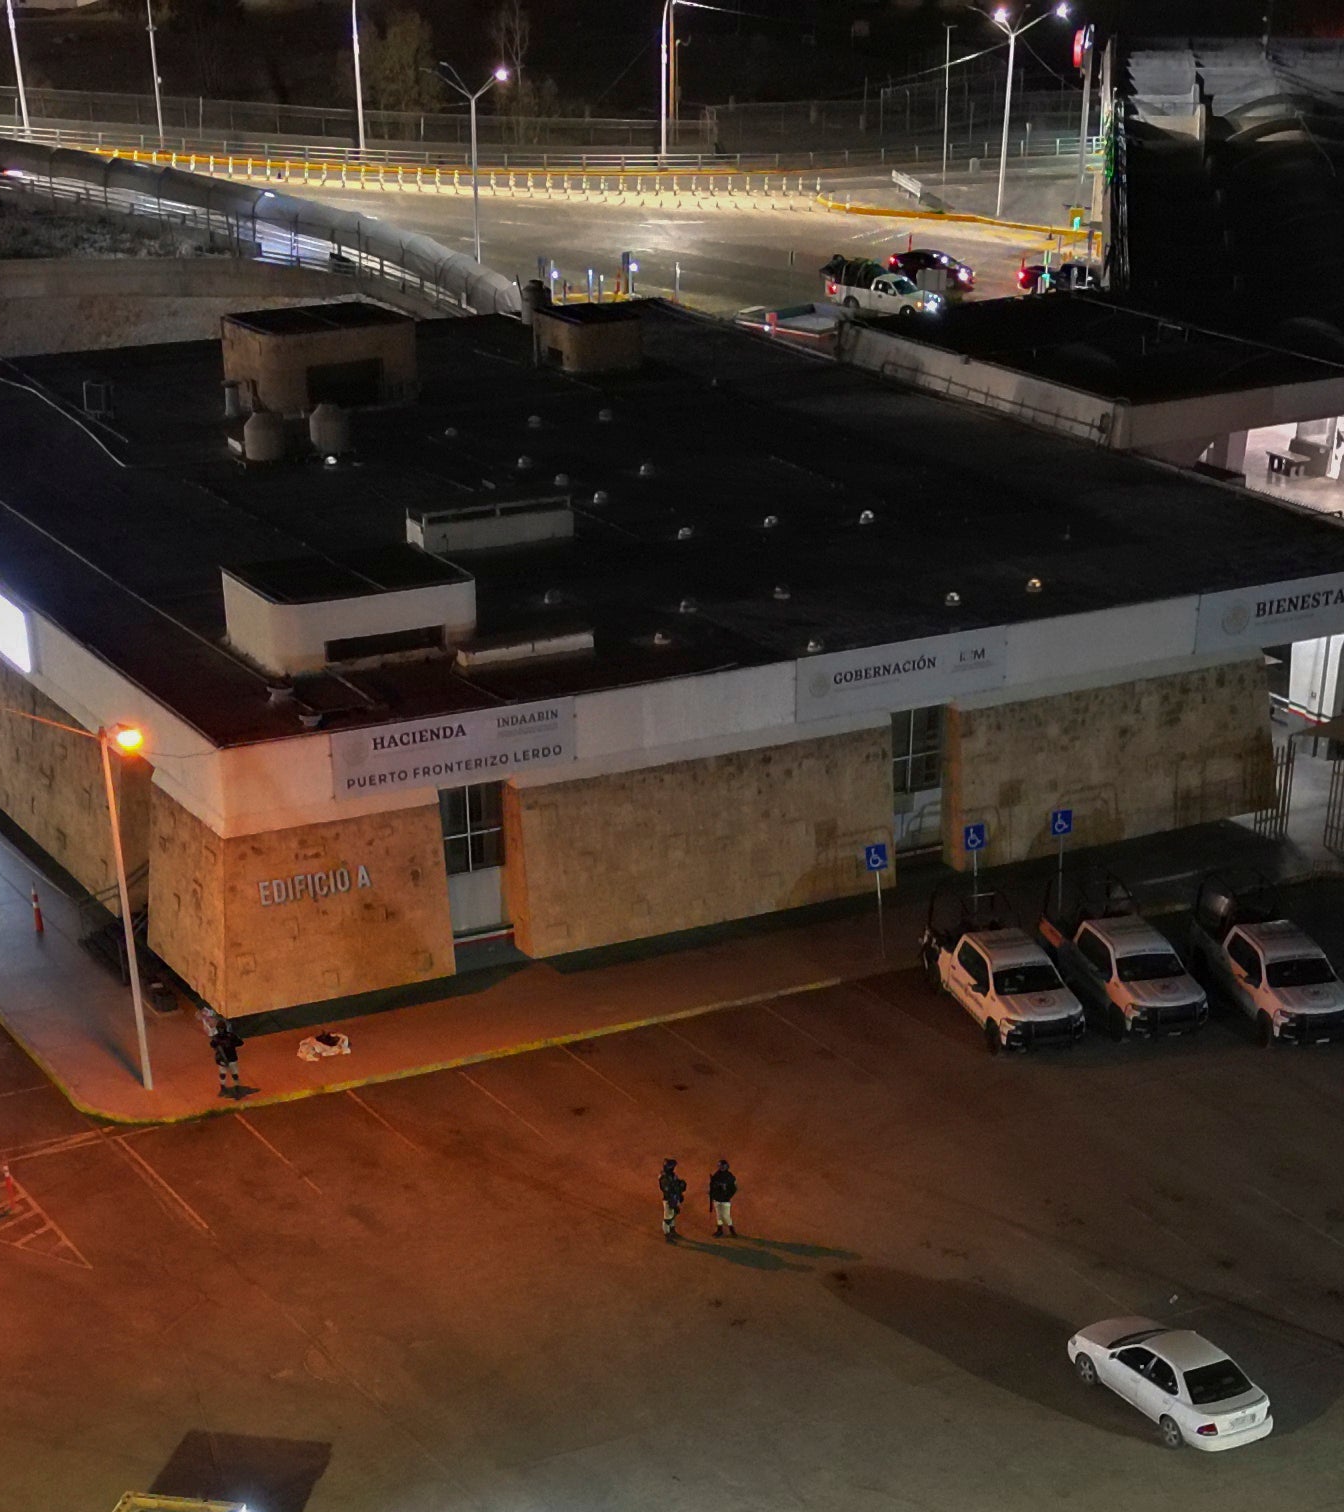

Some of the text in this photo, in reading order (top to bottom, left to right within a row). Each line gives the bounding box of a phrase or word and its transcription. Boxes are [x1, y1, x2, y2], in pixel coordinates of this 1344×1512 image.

[833, 655, 937, 685] GOBERNACIÓN
[372, 708, 558, 750] HACIENDA INDAABIN
[347, 769, 407, 790] PUERTO
[413, 753, 509, 779] FRONTERIZO
[514, 744, 563, 763] LERDO
[259, 864, 371, 906] EDIFICIO A
